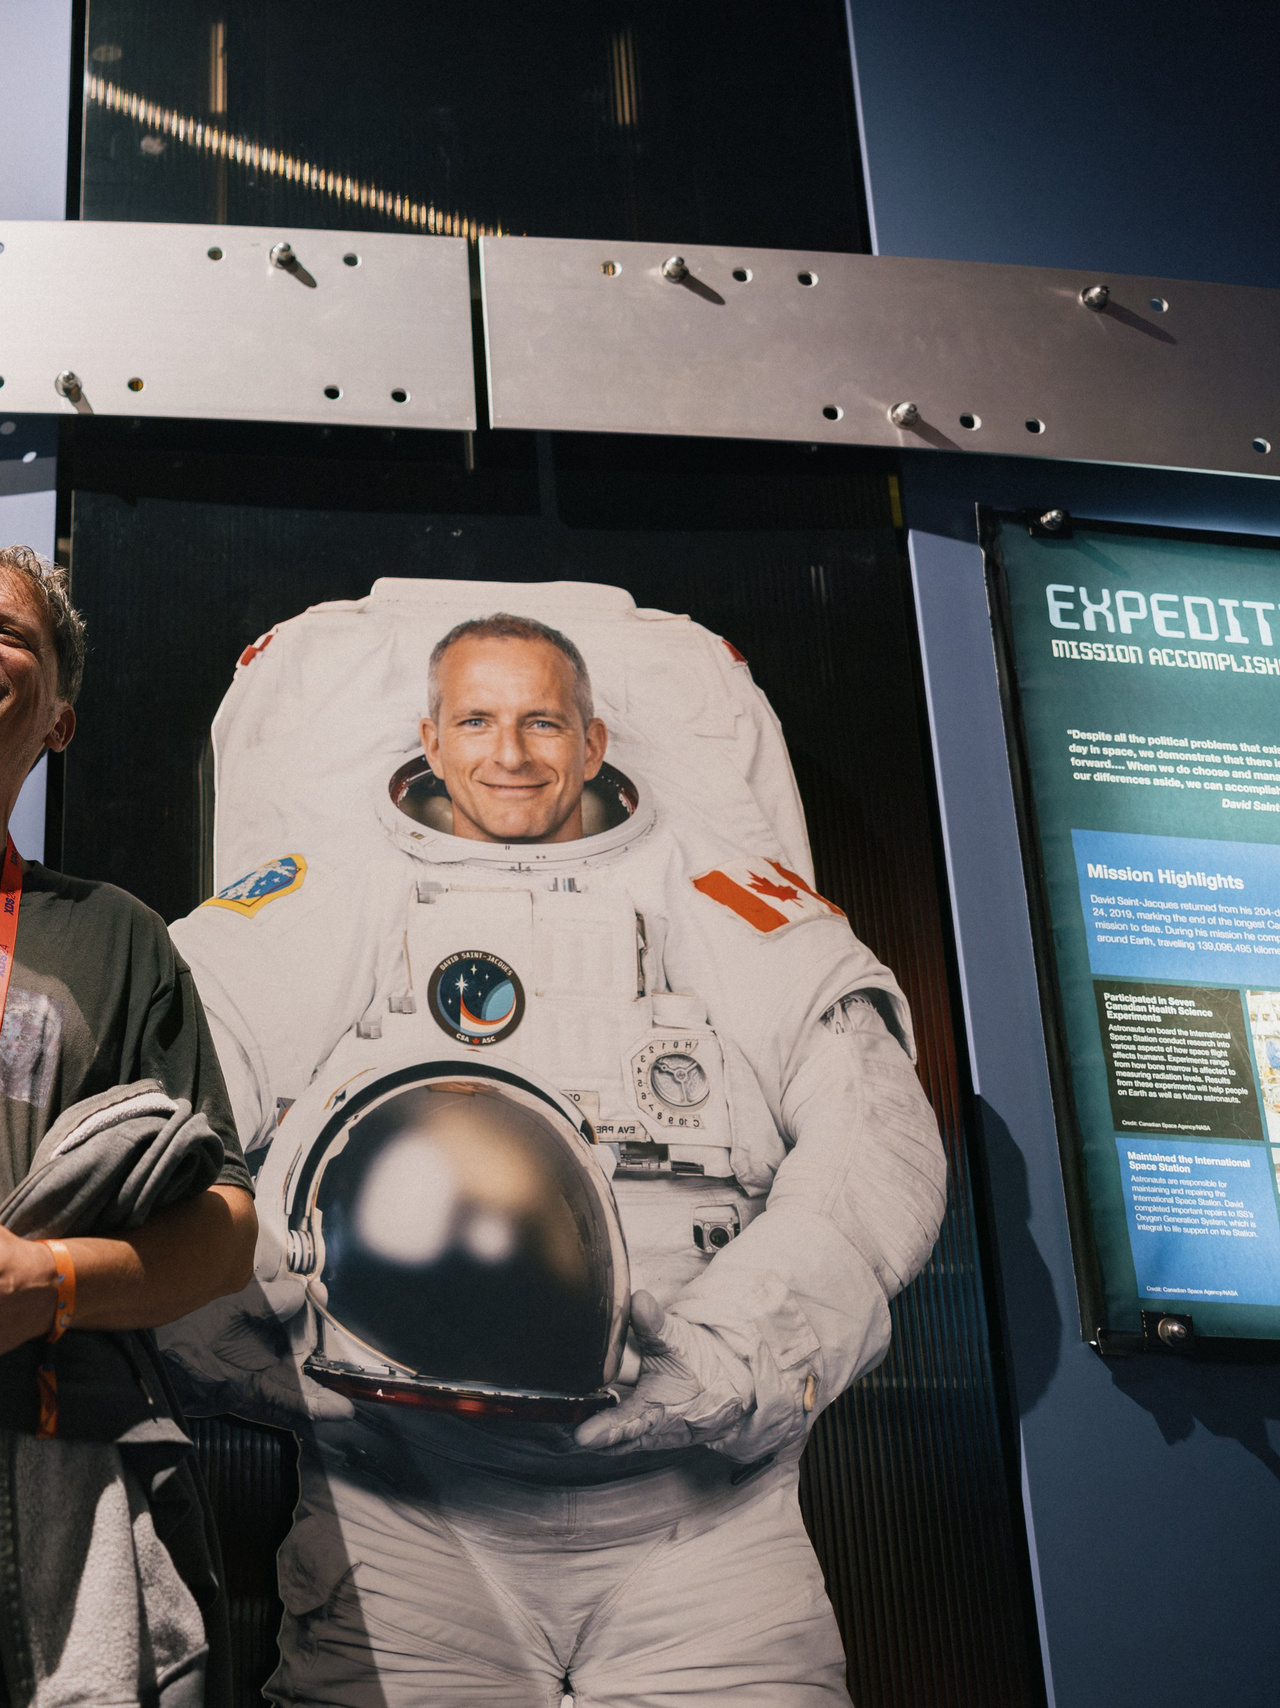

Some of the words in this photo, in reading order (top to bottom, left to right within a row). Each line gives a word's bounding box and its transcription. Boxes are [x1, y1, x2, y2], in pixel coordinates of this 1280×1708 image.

[1046, 584, 1280, 647] EXPEDIT
[1051, 639, 1144, 664] MISSION
[1148, 647, 1280, 675] ACCOMPLISH
[1067, 729, 1112, 742] “Despite
[1114, 733, 1127, 742] all
[1128, 733, 1146, 744] the
[1147, 736, 1189, 747] political
[1190, 739, 1239, 751] problems
[1238, 742, 1262, 753] that
[1261, 744, 1280, 755] exis
[1069, 743, 1088, 755] day
[1090, 744, 1101, 754] in
[1102, 747, 1137, 758] space,
[1138, 750, 1155, 758] we
[1156, 749, 1222, 763] demonstrate
[1222, 754, 1245, 765] that
[1245, 756, 1273, 768] there
[1070, 757, 1125, 770] forward....
[1126, 760, 1157, 772] When
[1158, 764, 1175, 773] we
[1176, 764, 1191, 775] do
[1192, 765, 1230, 778] choose
[1231, 769, 1252, 780] and
[1252, 772, 1280, 782] mana
[1073, 772, 1091, 780] our
[1093, 772, 1152, 785] differences
[1152, 777, 1185, 789] aside,
[1185, 780, 1202, 789] we
[1203, 782, 1223, 791] can
[1221, 798, 1252, 810] David
[1253, 800, 1280, 813] Saint
[1087, 863, 1154, 883] Mission
[1157, 868, 1245, 891] Highlights
[1090, 894, 1116, 904] David
[1117, 896, 1179, 910] Saint-Jacques
[1180, 902, 1217, 913] returned
[1218, 903, 1239, 914] from
[1238, 905, 1253, 916] his
[1092, 907, 1108, 917] 24,
[1109, 908, 1135, 919] 2019,
[1136, 912, 1172, 924] marking
[1172, 913, 1187, 923] the
[1188, 915, 1206, 924] end
[1207, 916, 1217, 925] of
[1217, 916, 1233, 927] the
[1233, 917, 1266, 930] longest
[1095, 921, 1129, 930] mission
[1130, 923, 1140, 932] to
[1141, 924, 1163, 934] date.
[1164, 925, 1194, 938] During
[1194, 927, 1209, 938] his
[1209, 929, 1243, 940] mission
[1243, 931, 1256, 941] he
[1097, 935, 1128, 944] around
[1129, 935, 1156, 947] Earth,
[1157, 938, 1196, 951] travelling
[1196, 941, 1253, 954] 139,096,495
[439, 955, 459, 971] DAVID
[461, 952, 514, 976] SAINT-JACQUES
[1103, 992, 1158, 1005] Participated
[1167, 997, 1196, 1008] Seven
[1105, 1001, 1147, 1012] Canadian
[1147, 1004, 1177, 1015] Health
[1177, 1006, 1213, 1018] Science
[1106, 1010, 1162, 1023] Experiments
[456, 1033, 470, 1043] CSA
[481, 1036, 496, 1044] ASC
[1127, 1151, 1177, 1163] Maintained
[1177, 1155, 1193, 1164] the
[1194, 1155, 1251, 1168] International
[1129, 1160, 1157, 1171] Space
[1158, 1162, 1191, 1174] Station
